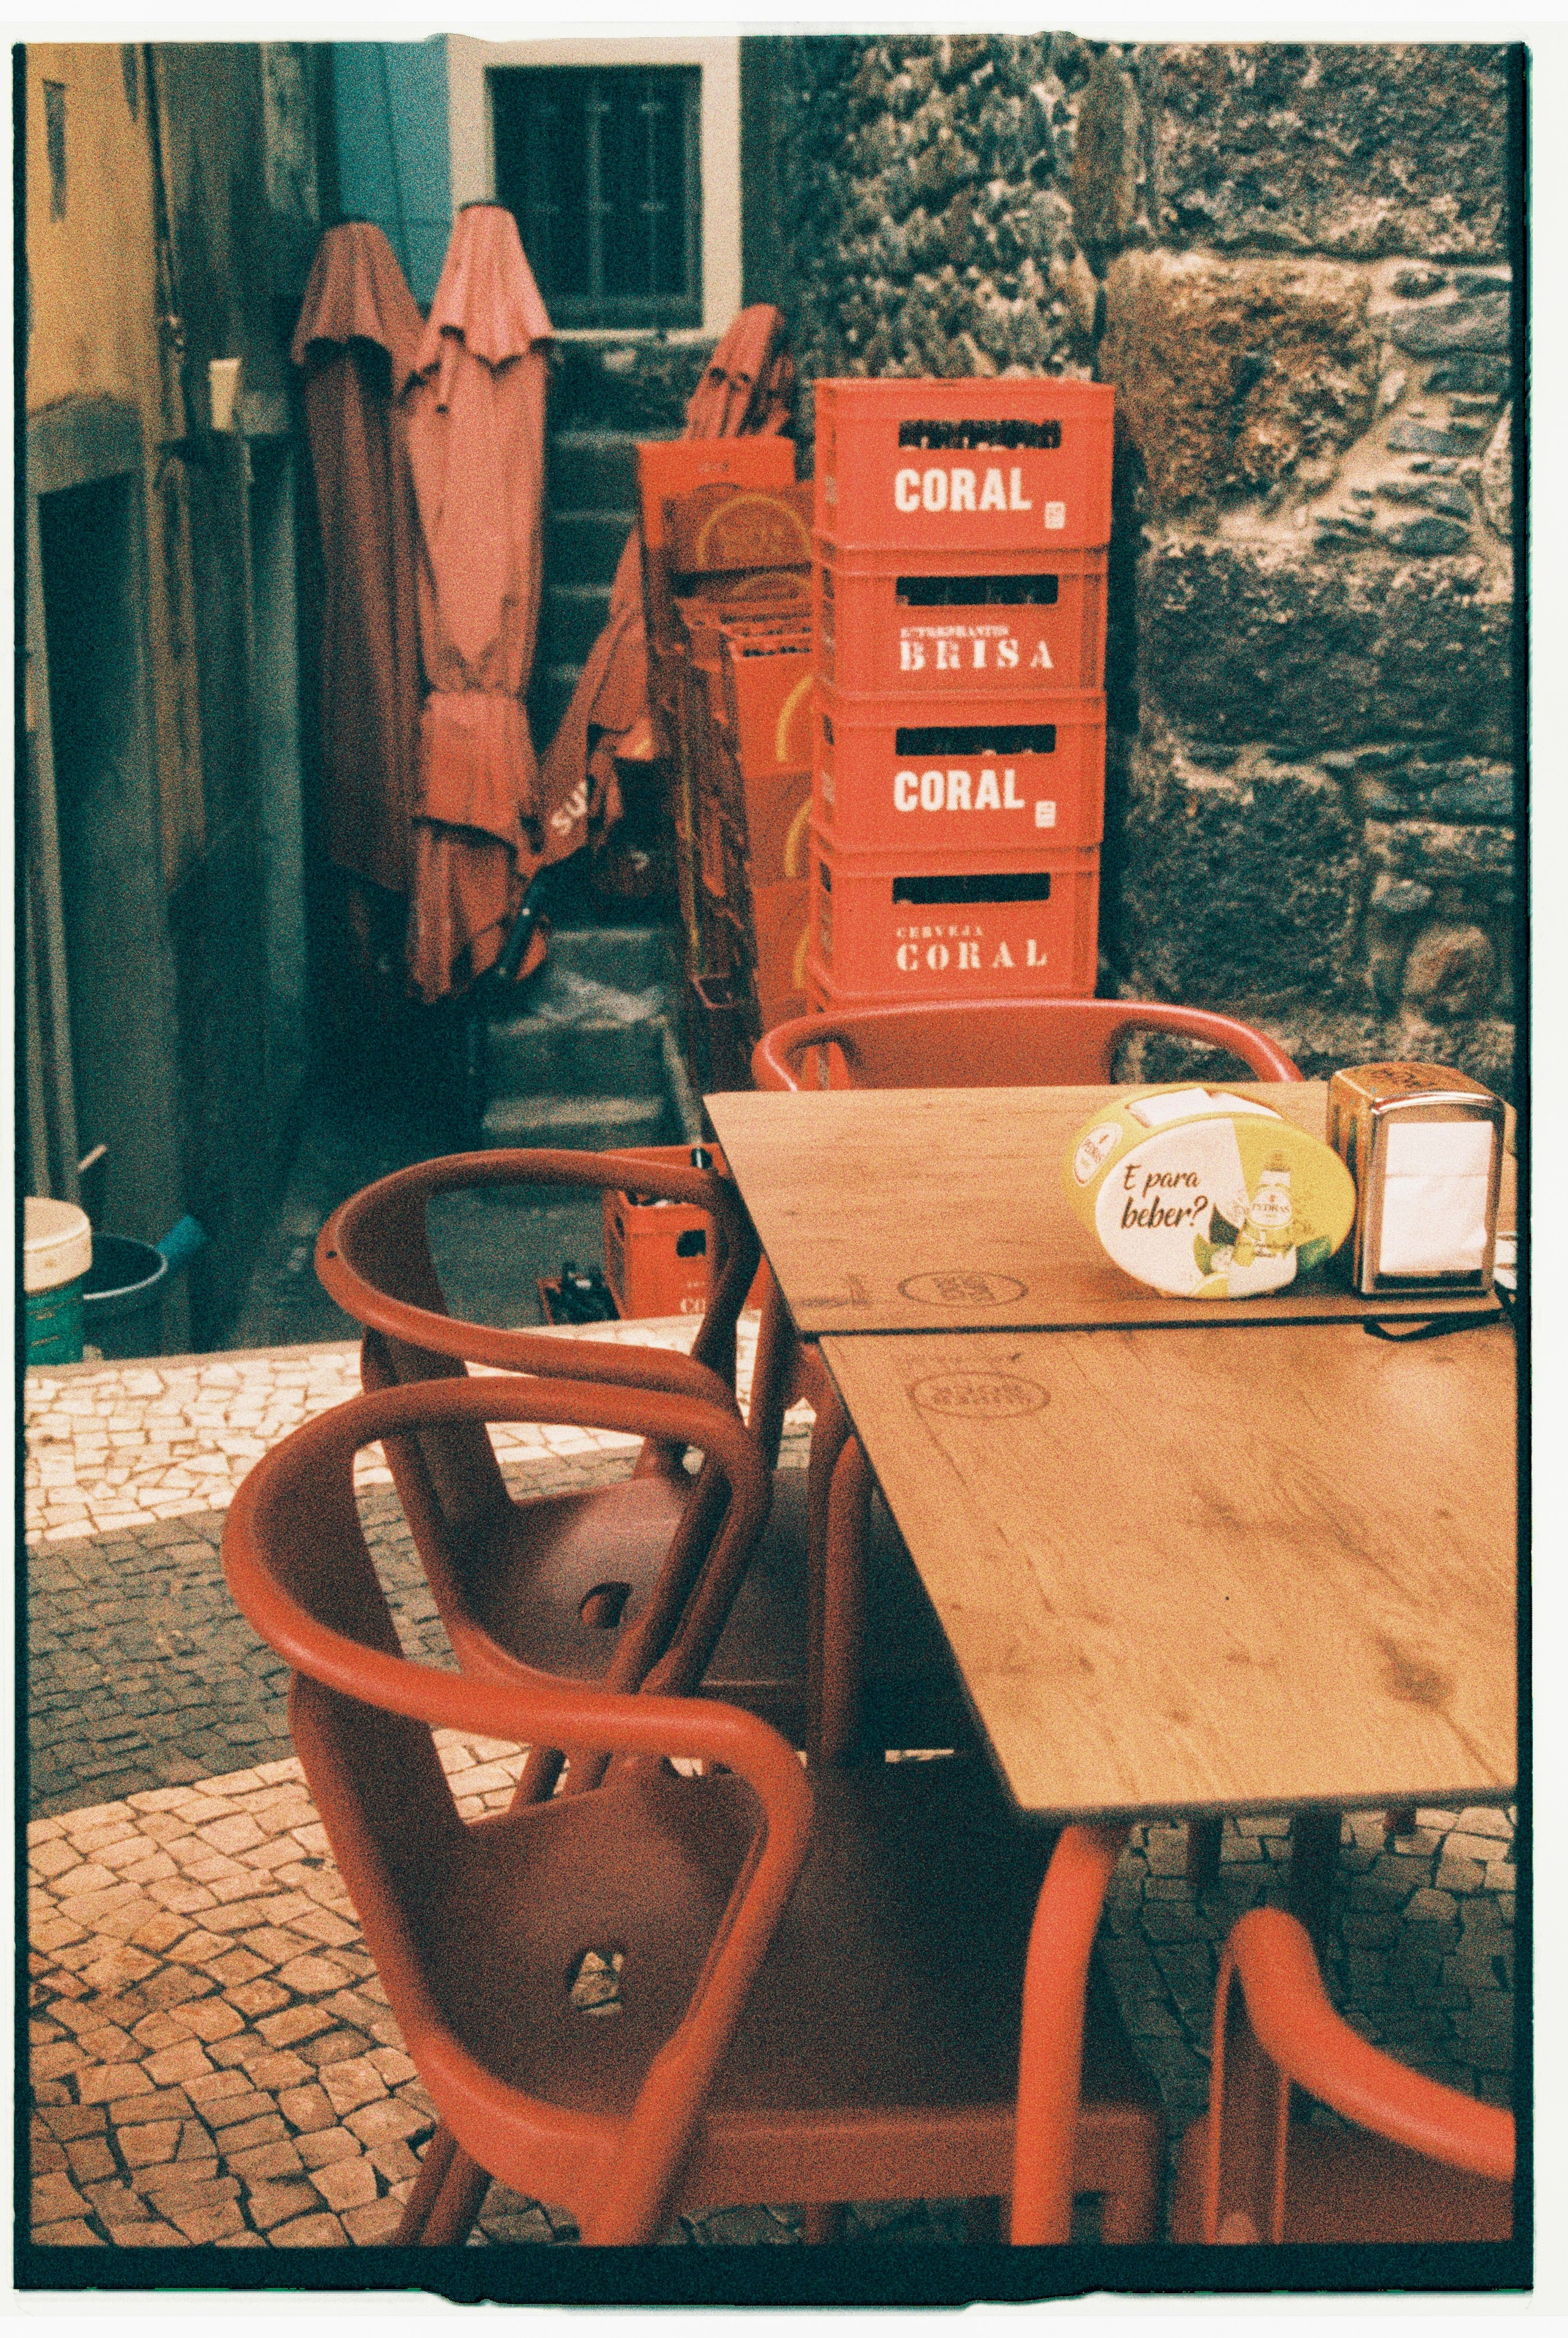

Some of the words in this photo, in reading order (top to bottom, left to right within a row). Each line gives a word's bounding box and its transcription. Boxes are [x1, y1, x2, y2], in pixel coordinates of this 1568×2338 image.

[895, 468, 1032, 512] CORAL
[900, 639, 1054, 671] BRISA
[894, 769, 1025, 812] CORAL
[896, 926, 983, 939] CERVEJA
[896, 940, 1047, 971] CORAL
[1123, 1164, 1142, 1191] E
[1142, 1170, 1199, 1196] para
[1121, 1195, 1209, 1229] beber?
